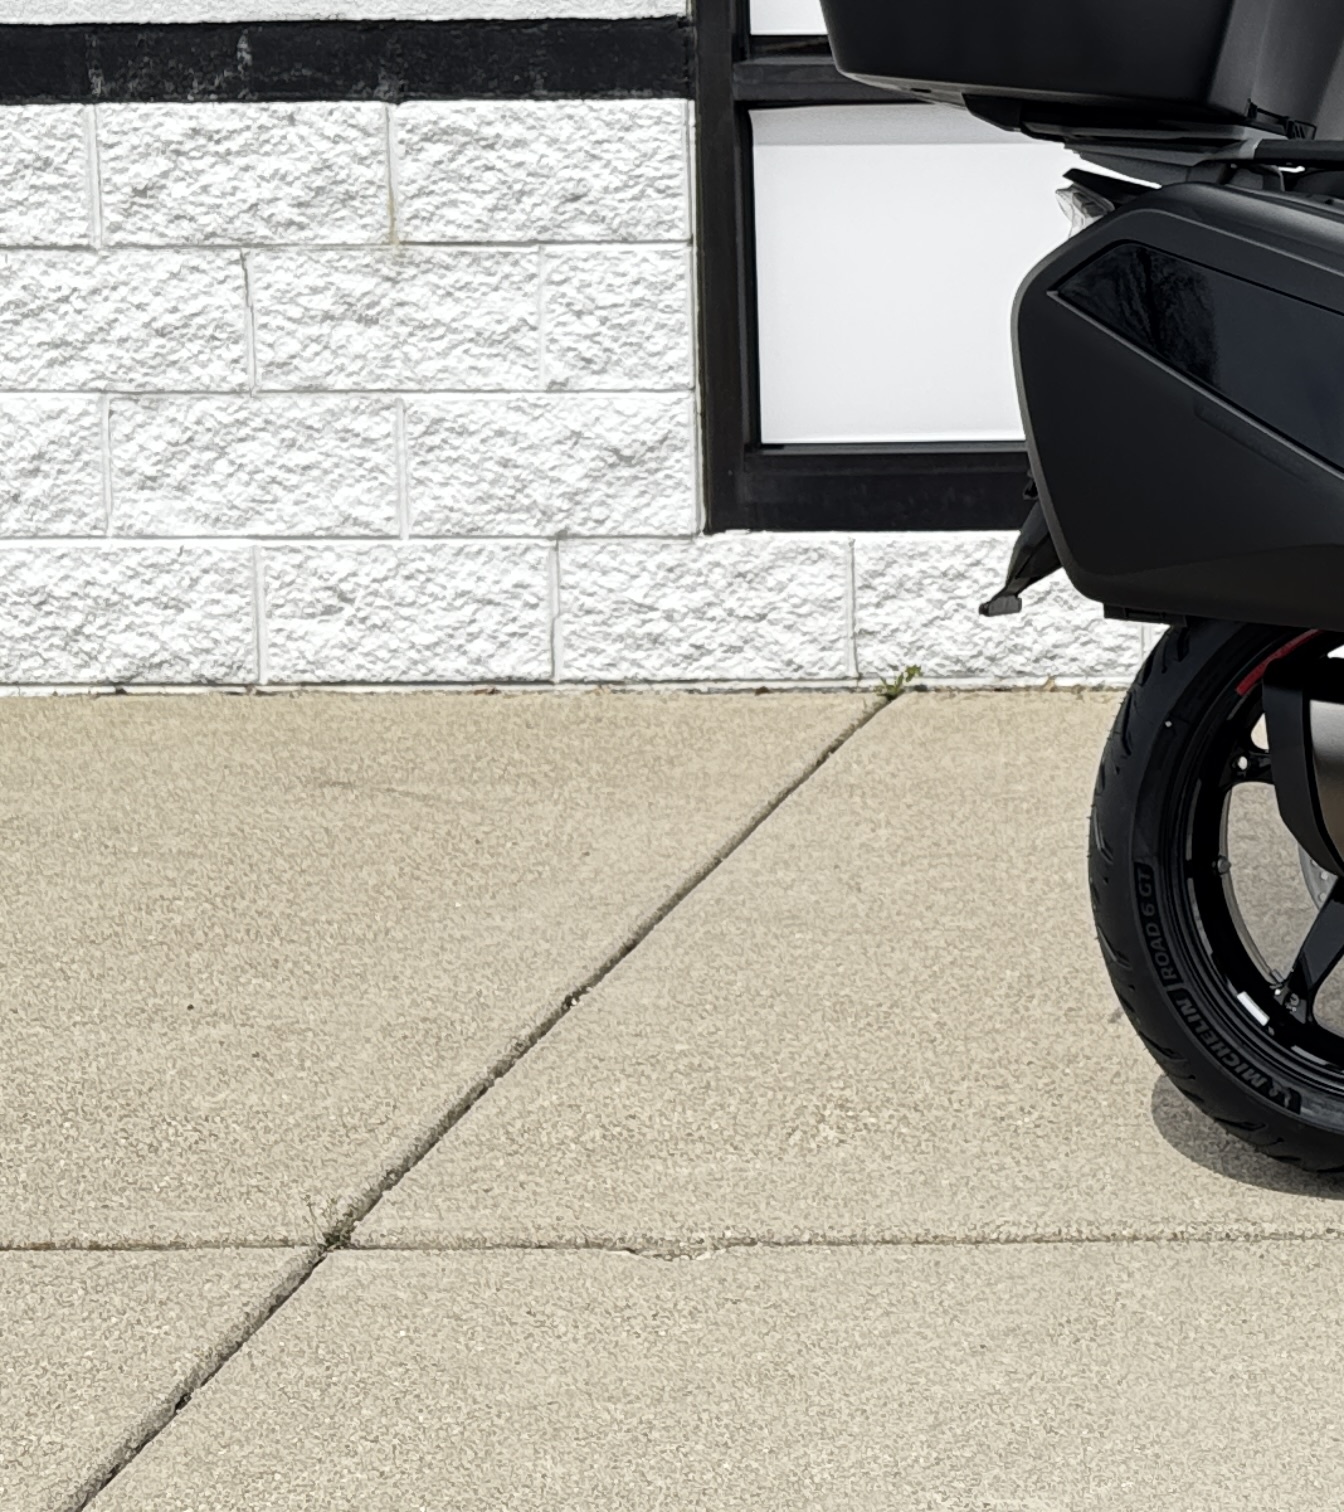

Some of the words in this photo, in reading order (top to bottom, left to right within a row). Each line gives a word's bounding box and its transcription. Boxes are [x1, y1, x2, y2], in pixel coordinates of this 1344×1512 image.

[1137, 870, 1156, 898] GT
[1142, 902, 1156, 917] 6
[1145, 921, 1180, 983] ROAD
[1175, 997, 1267, 1090] MICHELIN
